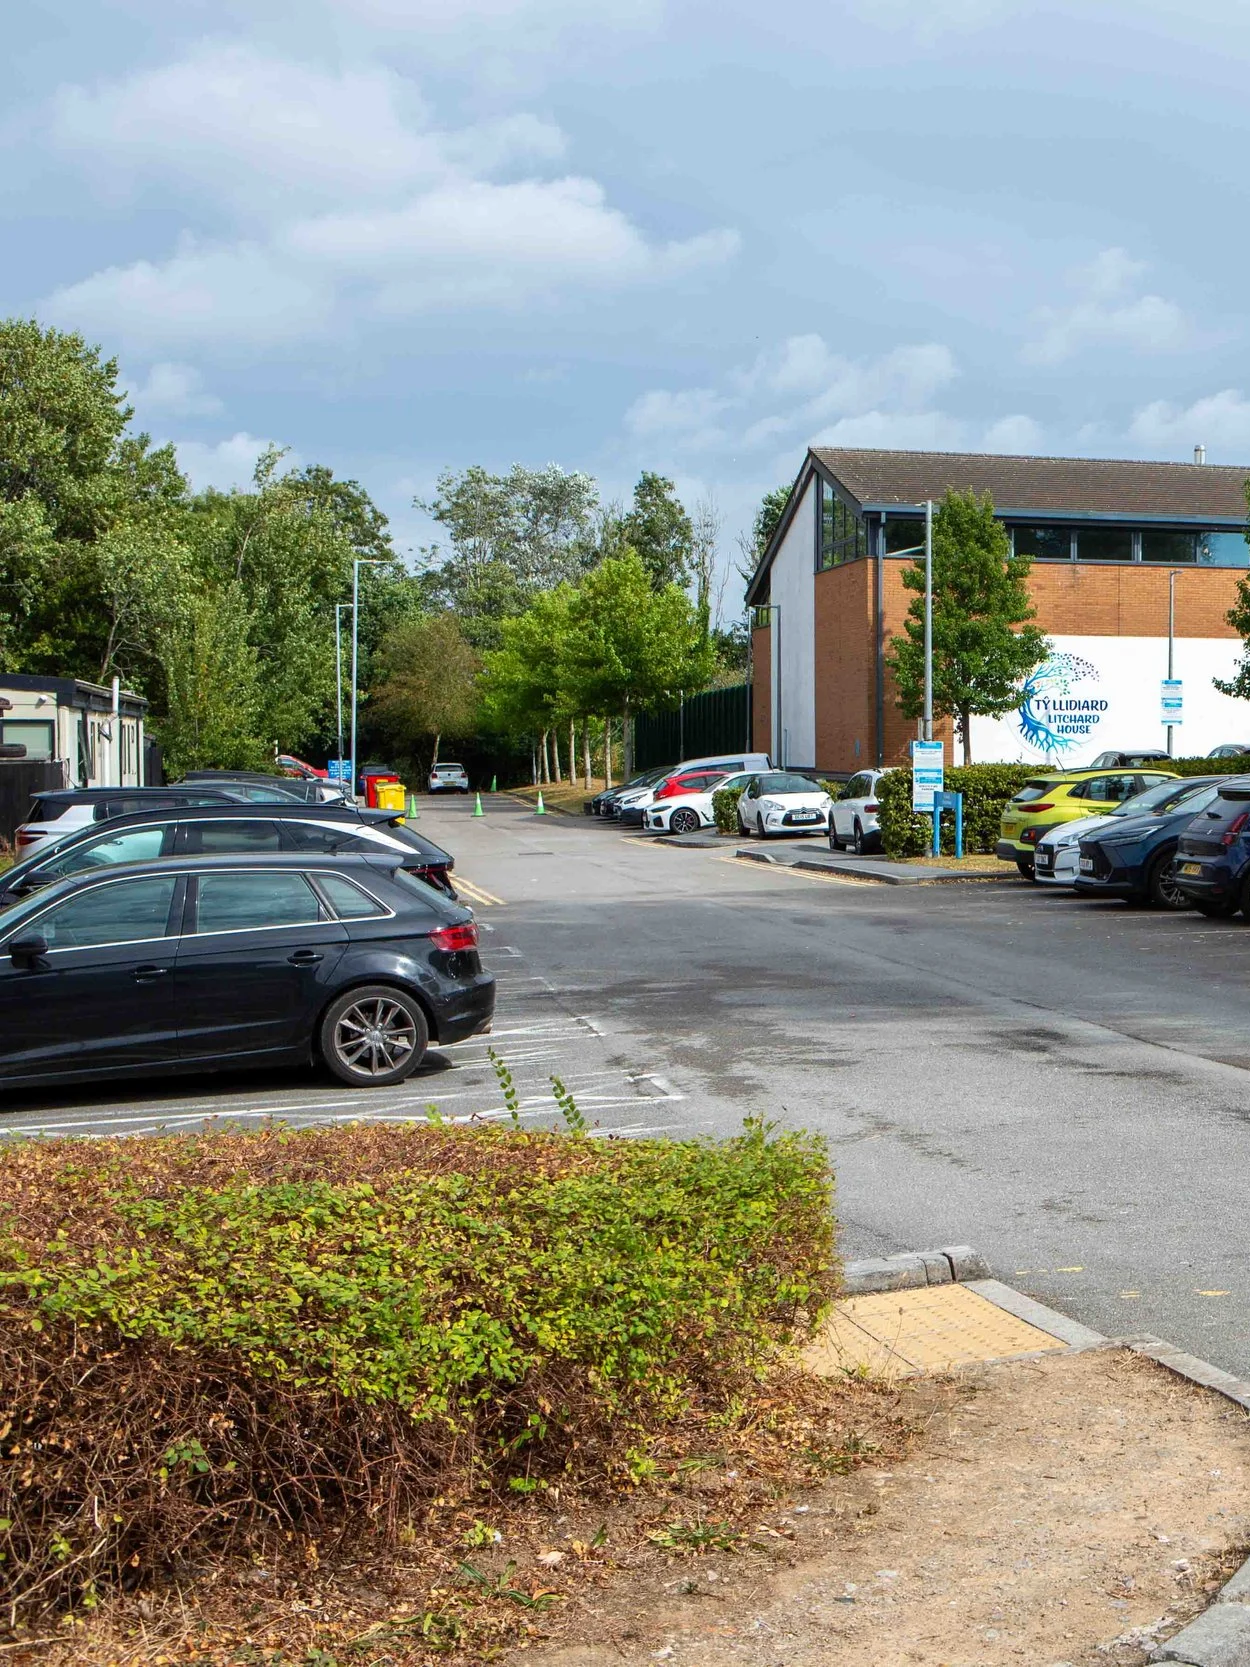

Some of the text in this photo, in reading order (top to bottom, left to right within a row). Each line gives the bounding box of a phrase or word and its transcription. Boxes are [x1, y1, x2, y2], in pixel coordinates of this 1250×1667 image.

[1053, 700, 1108, 711] LLIDIARD
[1048, 714, 1100, 723] LITCHARD
[1057, 725, 1091, 734] HOUSE
